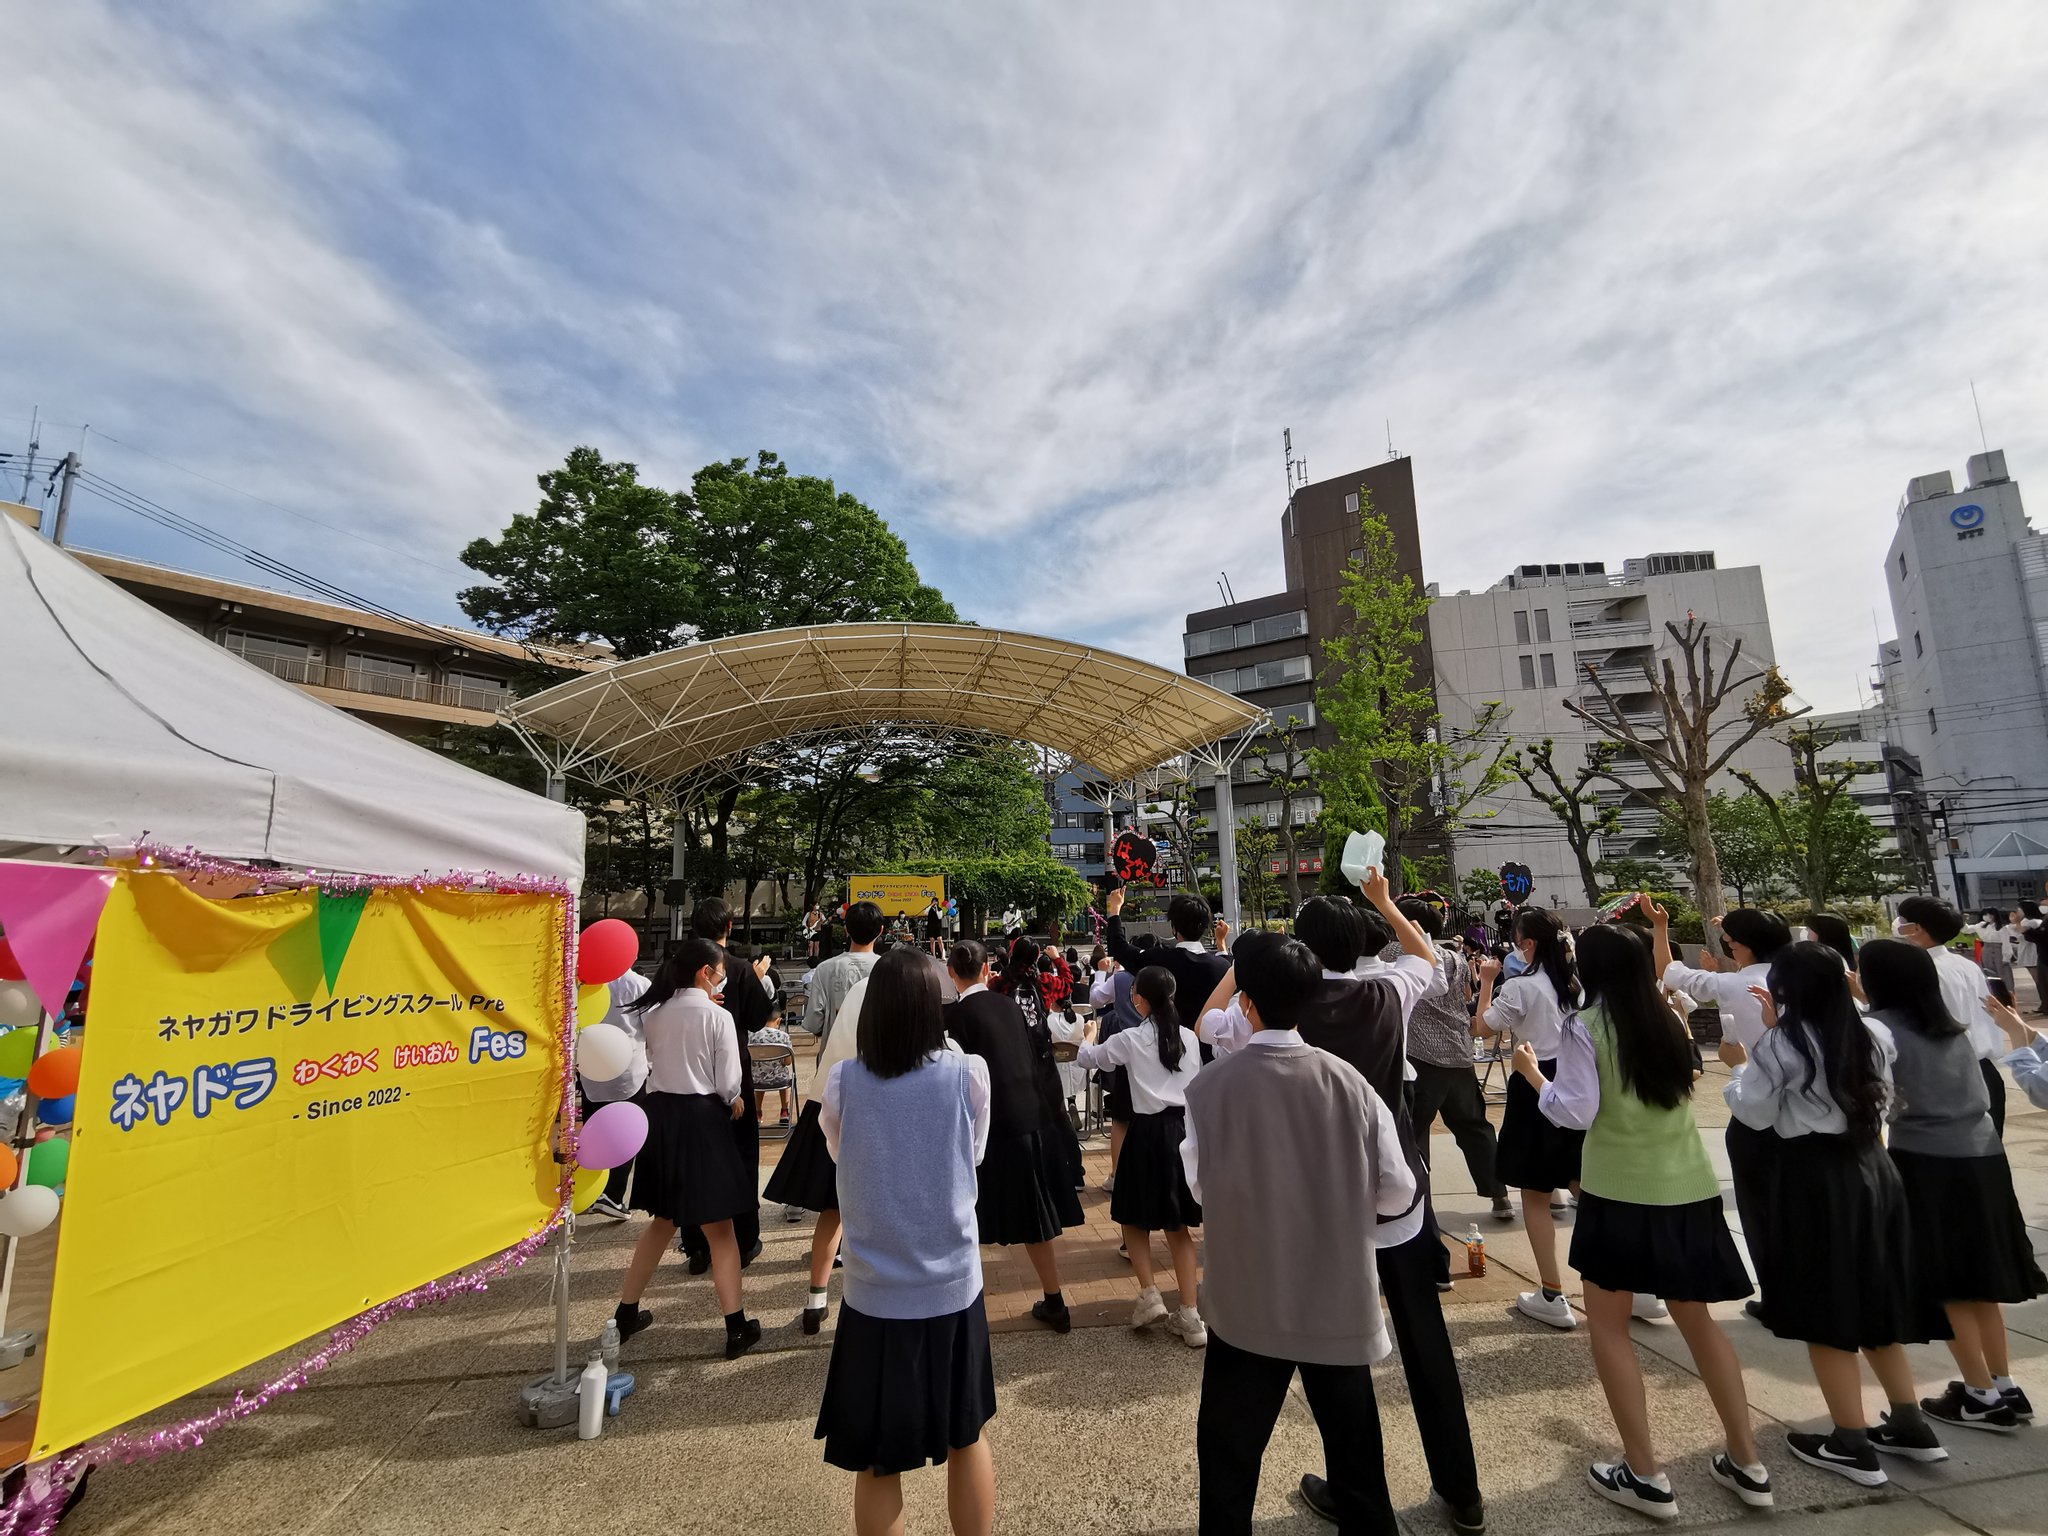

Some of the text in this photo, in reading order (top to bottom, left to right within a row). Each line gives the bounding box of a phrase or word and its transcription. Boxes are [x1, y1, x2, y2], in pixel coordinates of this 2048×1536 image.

[1957, 528, 1985, 541] NTT
[1505, 872, 1530, 894] もか
[468, 993, 505, 1012] Pre
[110, 1026, 527, 1131] ネヤドラ わくわく けいおん Fes
[306, 1095, 363, 1121] Since
[367, 1086, 402, 1107] 2022
